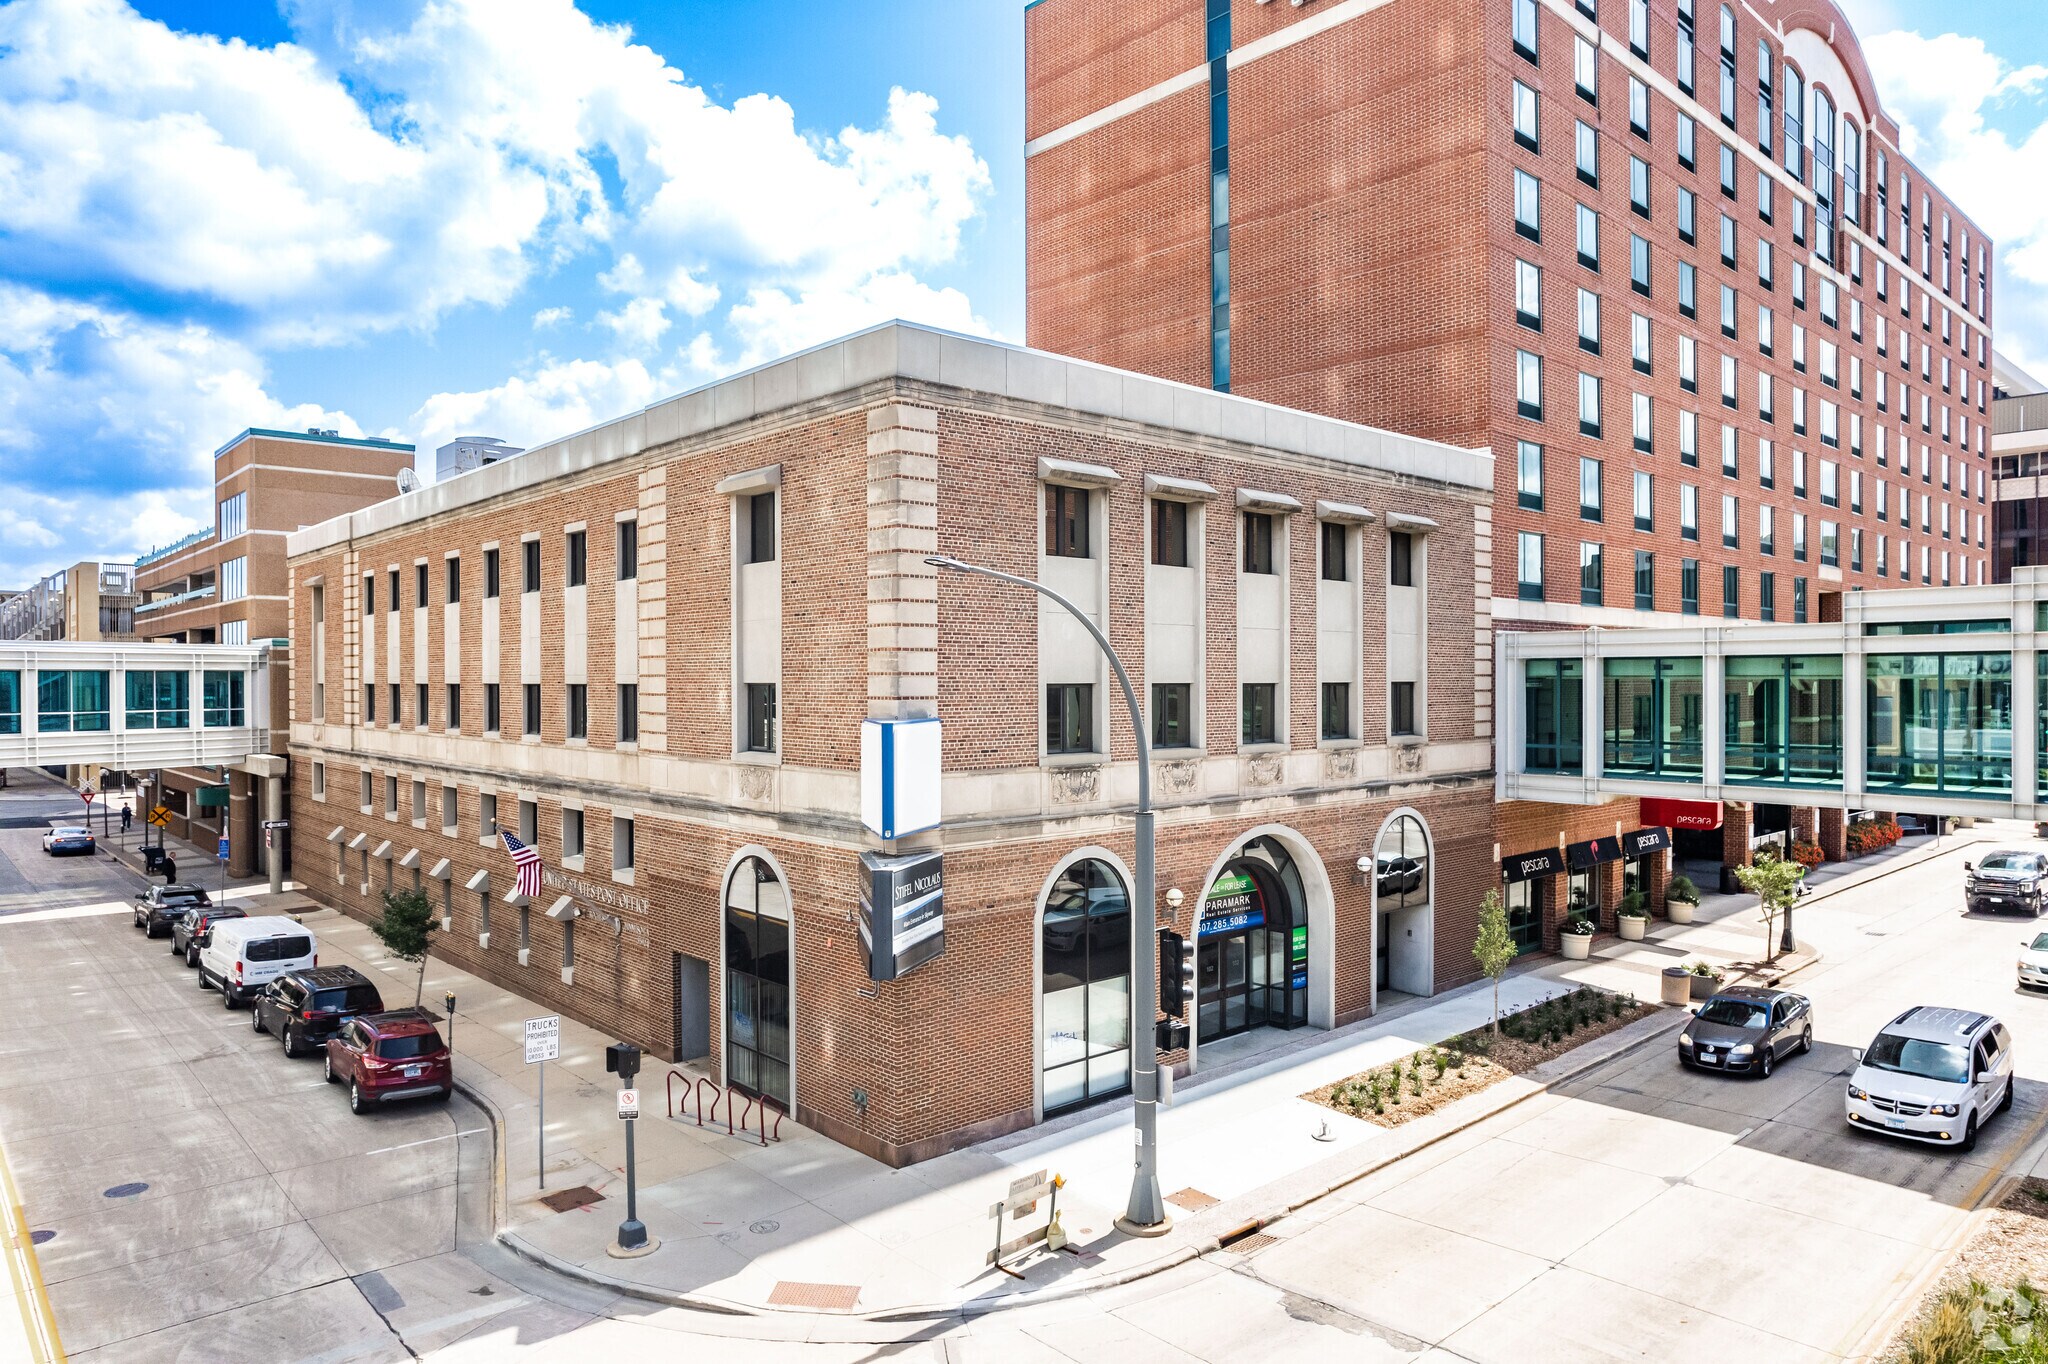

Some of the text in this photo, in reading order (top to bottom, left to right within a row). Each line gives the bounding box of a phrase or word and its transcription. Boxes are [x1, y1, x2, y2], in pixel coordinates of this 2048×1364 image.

[1676, 815, 1711, 825] pescara
[1637, 833, 1660, 849] pescara
[1521, 856, 1550, 875] pescara
[895, 883, 913, 900] STIFEL
[914, 872, 941, 893] NICOLAUS
[1224, 882, 1234, 891] FOR
[1233, 880, 1247, 889] LEASE
[597, 885, 616, 905] POST
[620, 893, 649, 914] OFFICE
[1206, 895, 1250, 911] PARAMARK
[527, 1019, 558, 1031] TRUCKS
[527, 1030, 558, 1040] PROHIBITED
